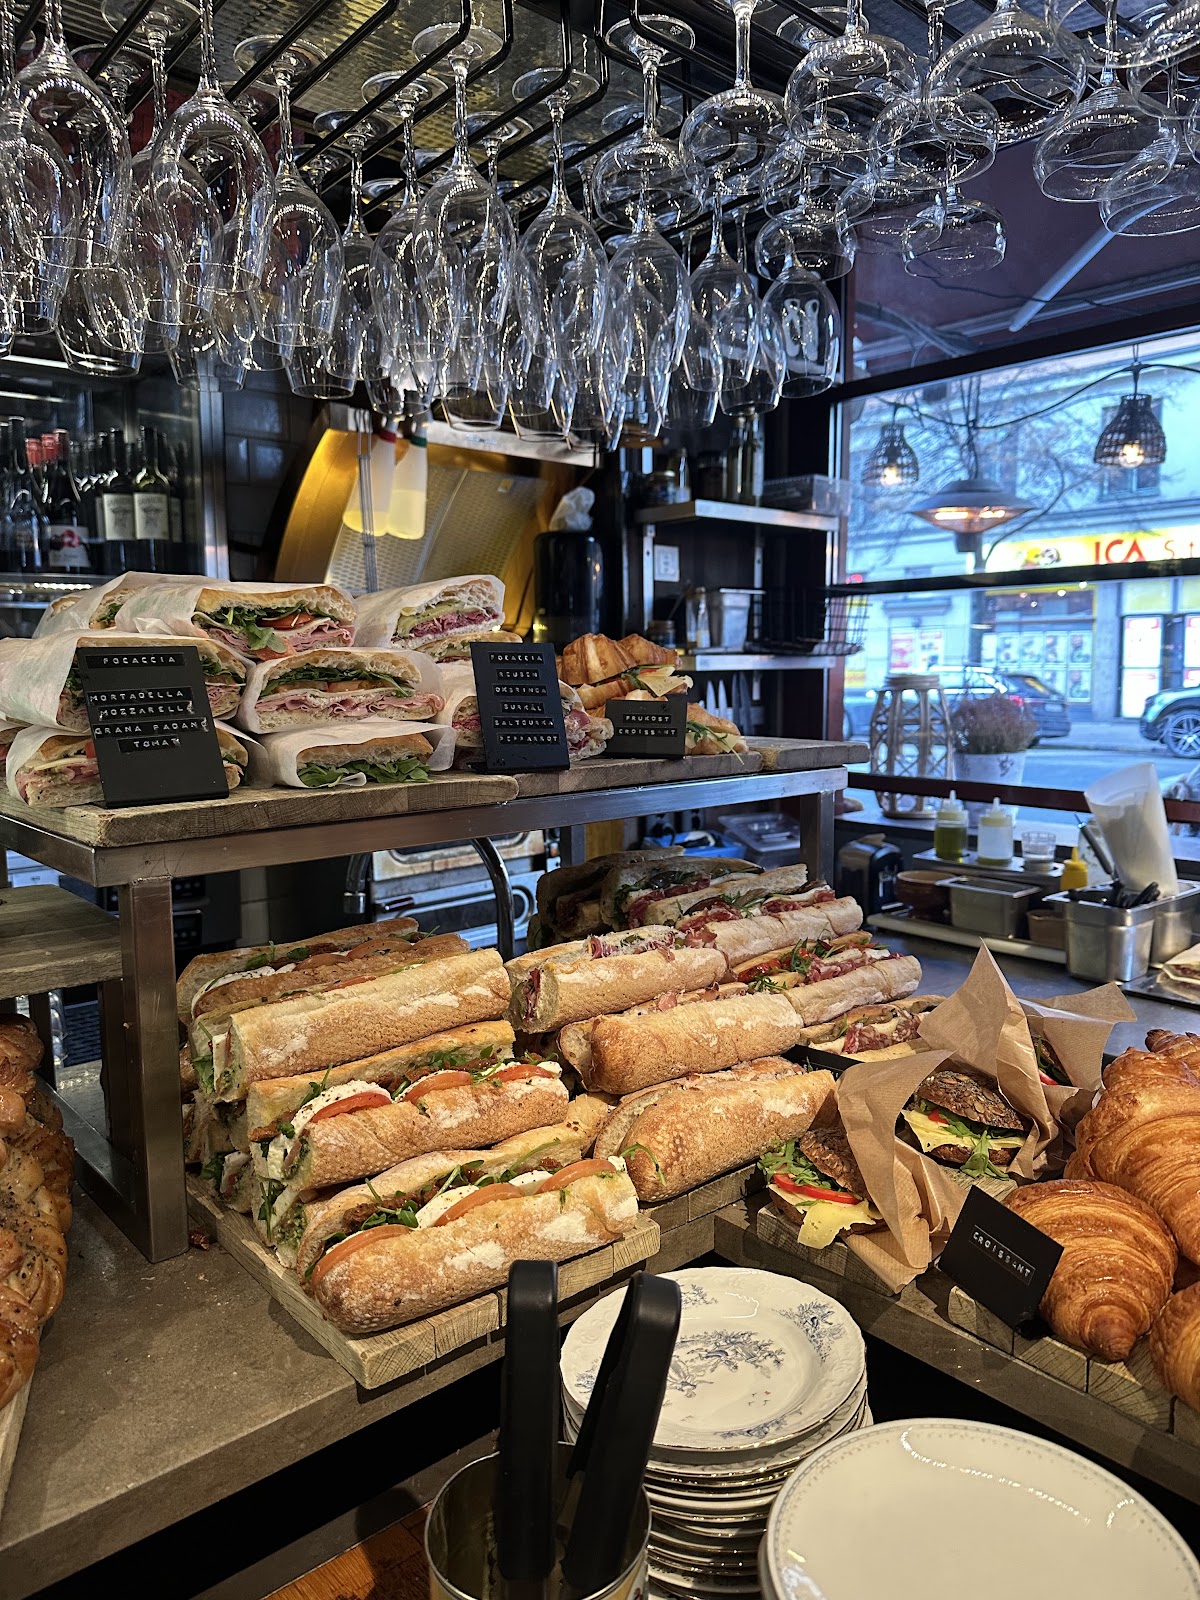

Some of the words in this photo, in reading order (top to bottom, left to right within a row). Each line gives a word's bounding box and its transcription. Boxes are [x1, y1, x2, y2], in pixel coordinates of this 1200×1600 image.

[1094, 539, 1146, 565] ICA
[103, 656, 175, 664] FOCACCIA
[490, 654, 543, 662] FOCACCIA
[89, 690, 184, 702] MORTADELLA
[99, 701, 195, 718] MOZZARELLA
[494, 719, 554, 727] SALTGURKA
[94, 725, 142, 735] GRANA
[618, 728, 676, 736] CROISSANT
[973, 1231, 1031, 1277] CROISSANT
